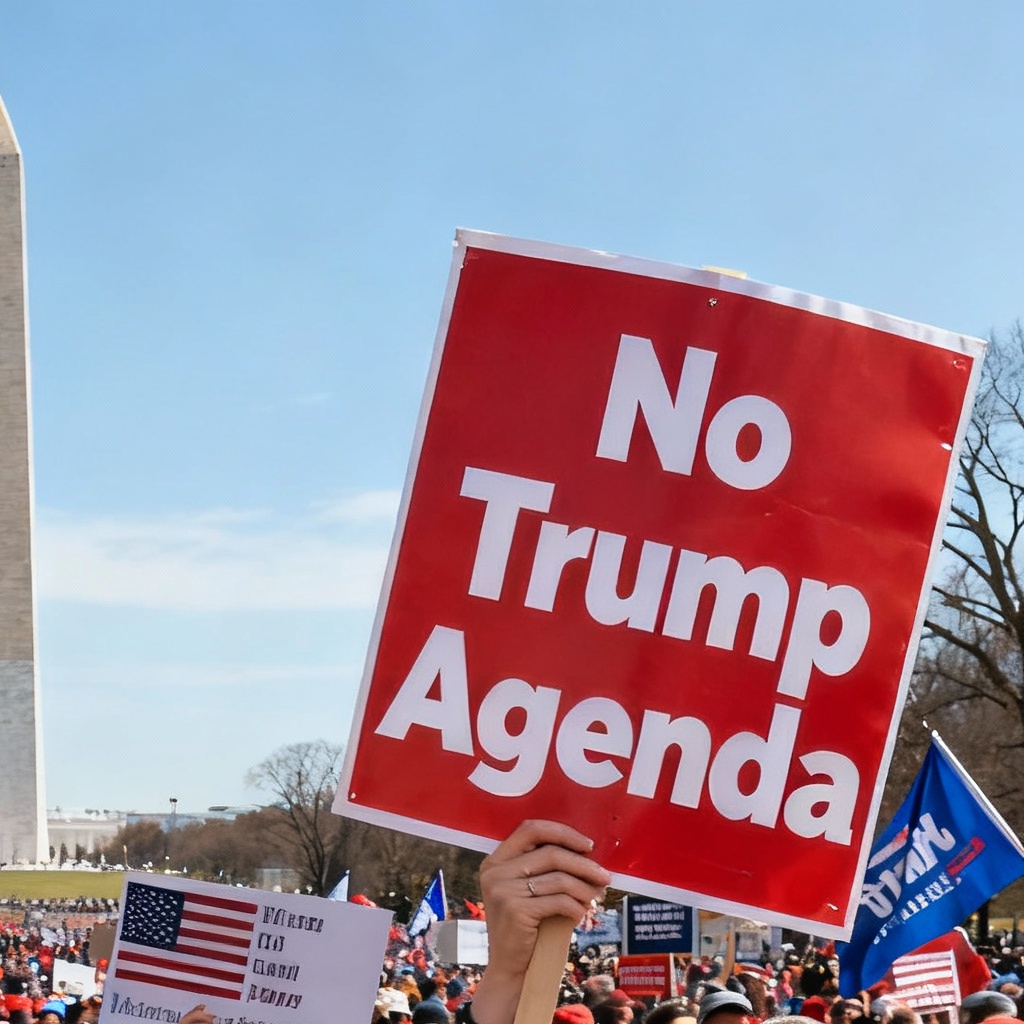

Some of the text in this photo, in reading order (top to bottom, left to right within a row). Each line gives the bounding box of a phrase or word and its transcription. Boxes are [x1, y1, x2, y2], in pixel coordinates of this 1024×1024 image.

[595, 333, 792, 491] No
[459, 465, 871, 701] Trump
[374, 624, 861, 846] Agenda
